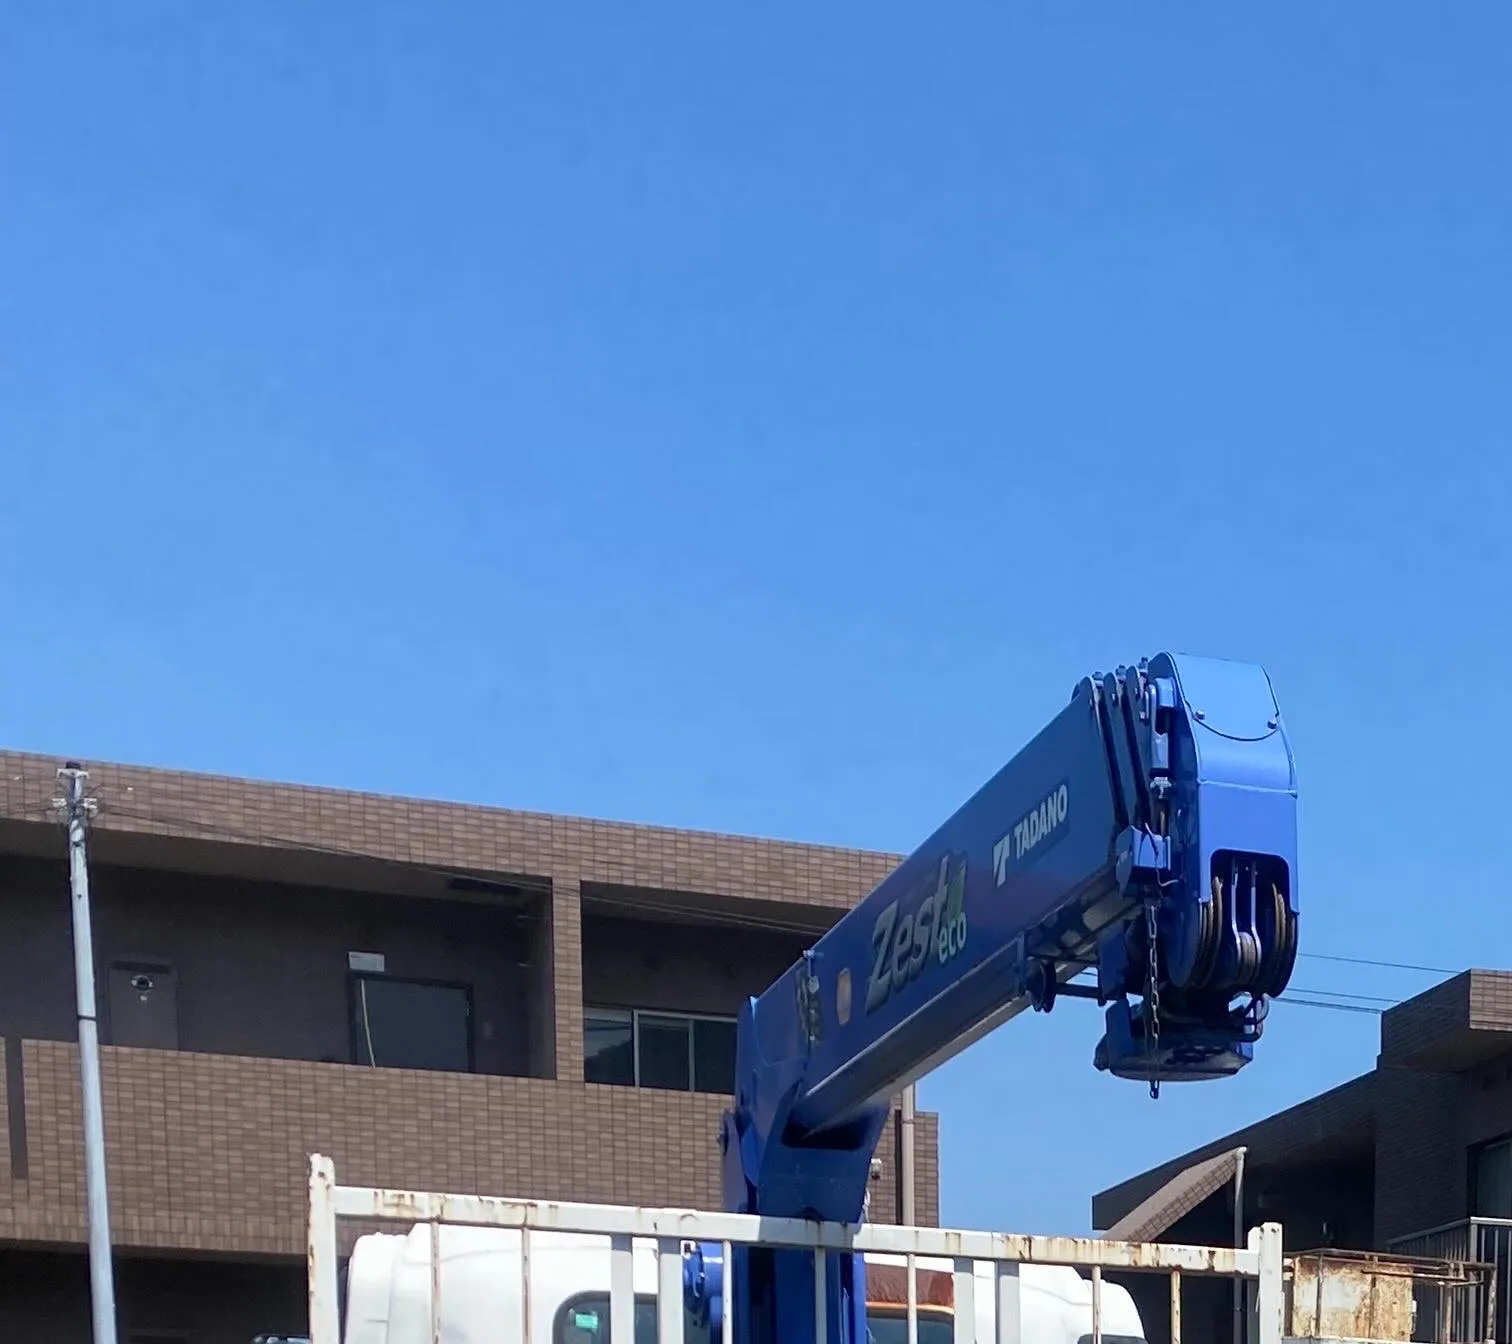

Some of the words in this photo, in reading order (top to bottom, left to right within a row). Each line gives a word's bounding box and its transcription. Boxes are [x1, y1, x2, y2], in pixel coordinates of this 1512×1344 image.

[1014, 783, 1068, 860] TADANO
[865, 854, 948, 1015] Zest
[938, 911, 967, 964] eco
